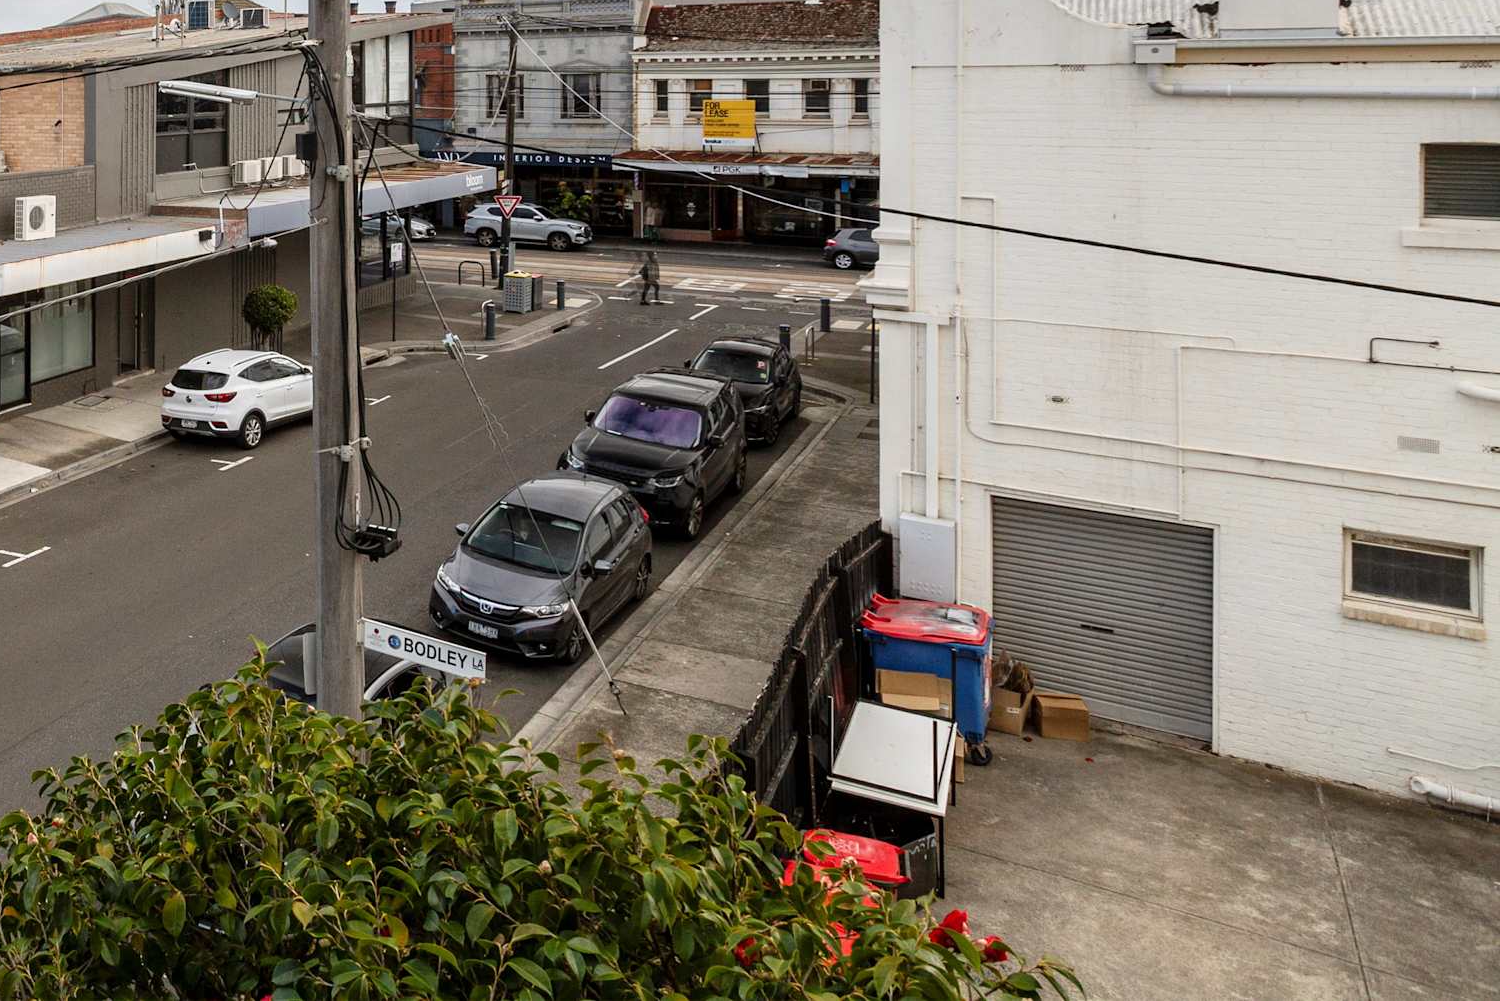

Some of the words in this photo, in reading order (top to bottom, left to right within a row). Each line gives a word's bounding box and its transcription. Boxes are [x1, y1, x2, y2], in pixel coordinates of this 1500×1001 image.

[704, 101, 720, 109] FOR
[704, 109, 729, 118] LEASE
[493, 153, 551, 163] INERIOR
[404, 637, 468, 669] BODLEY
[472, 657, 484, 670] LA
